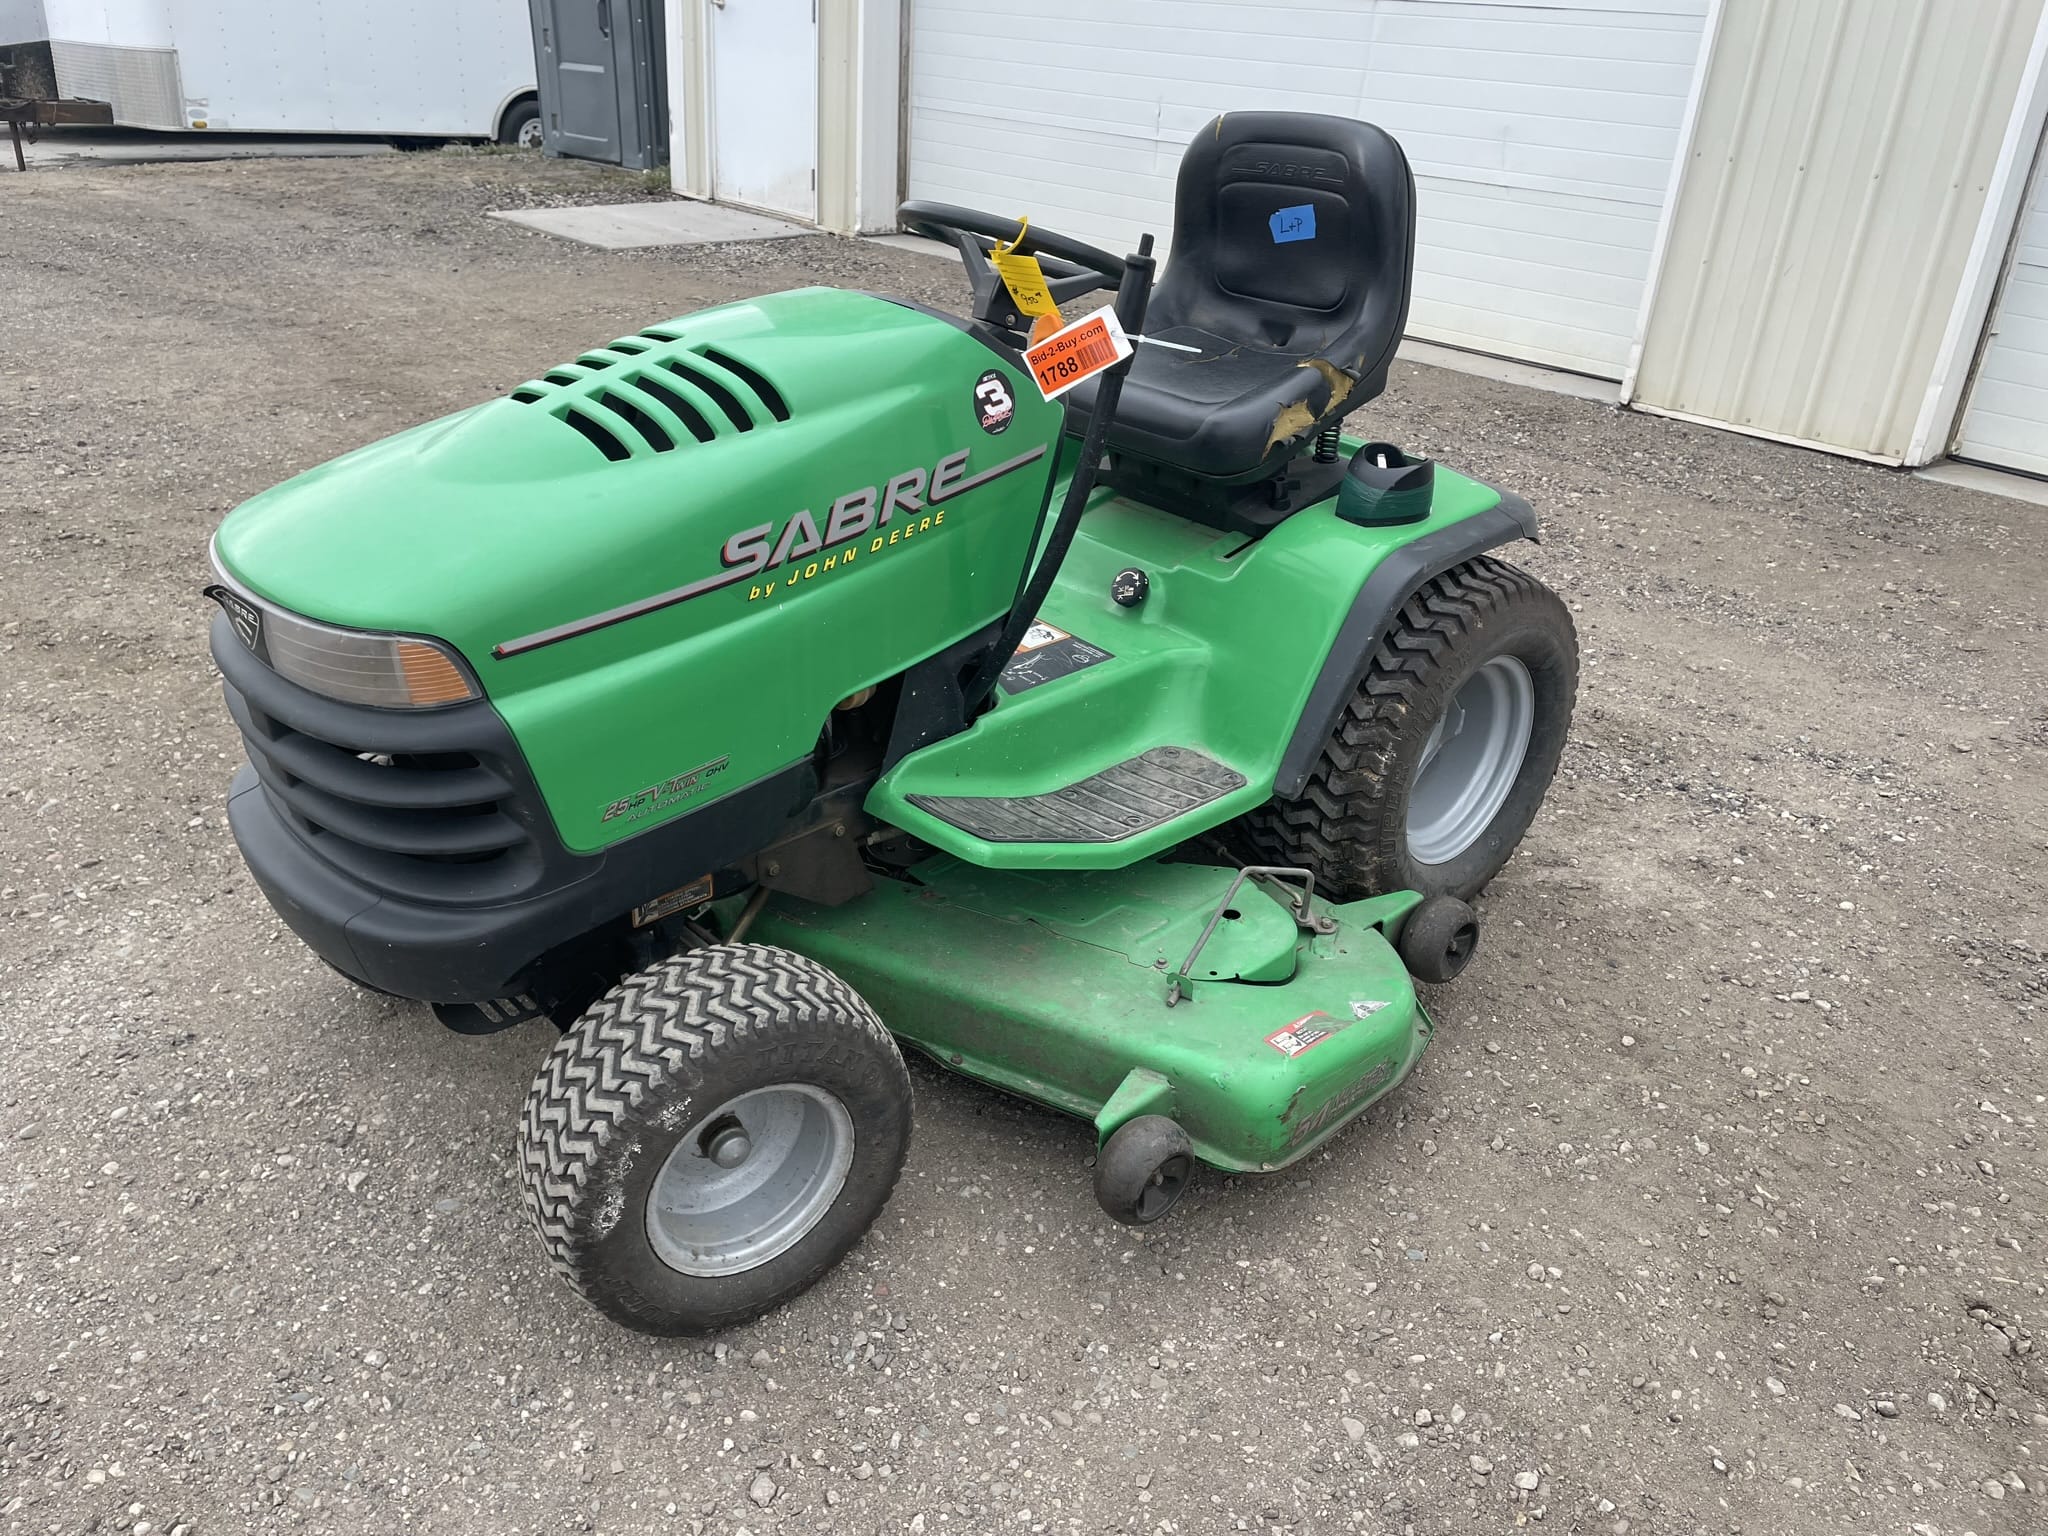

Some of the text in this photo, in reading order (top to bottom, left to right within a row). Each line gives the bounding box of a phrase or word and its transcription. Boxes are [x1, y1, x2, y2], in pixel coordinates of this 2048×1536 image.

[1255, 161, 1328, 180] SABRE
[1030, 325, 1104, 366] Bid-2-Buy.com
[1040, 356, 1079, 386] 1788
[976, 378, 1013, 416] 3
[720, 448, 971, 574] SABRE
[749, 511, 945, 601] by JOHN DEERE
[705, 761, 730, 778] OHV
